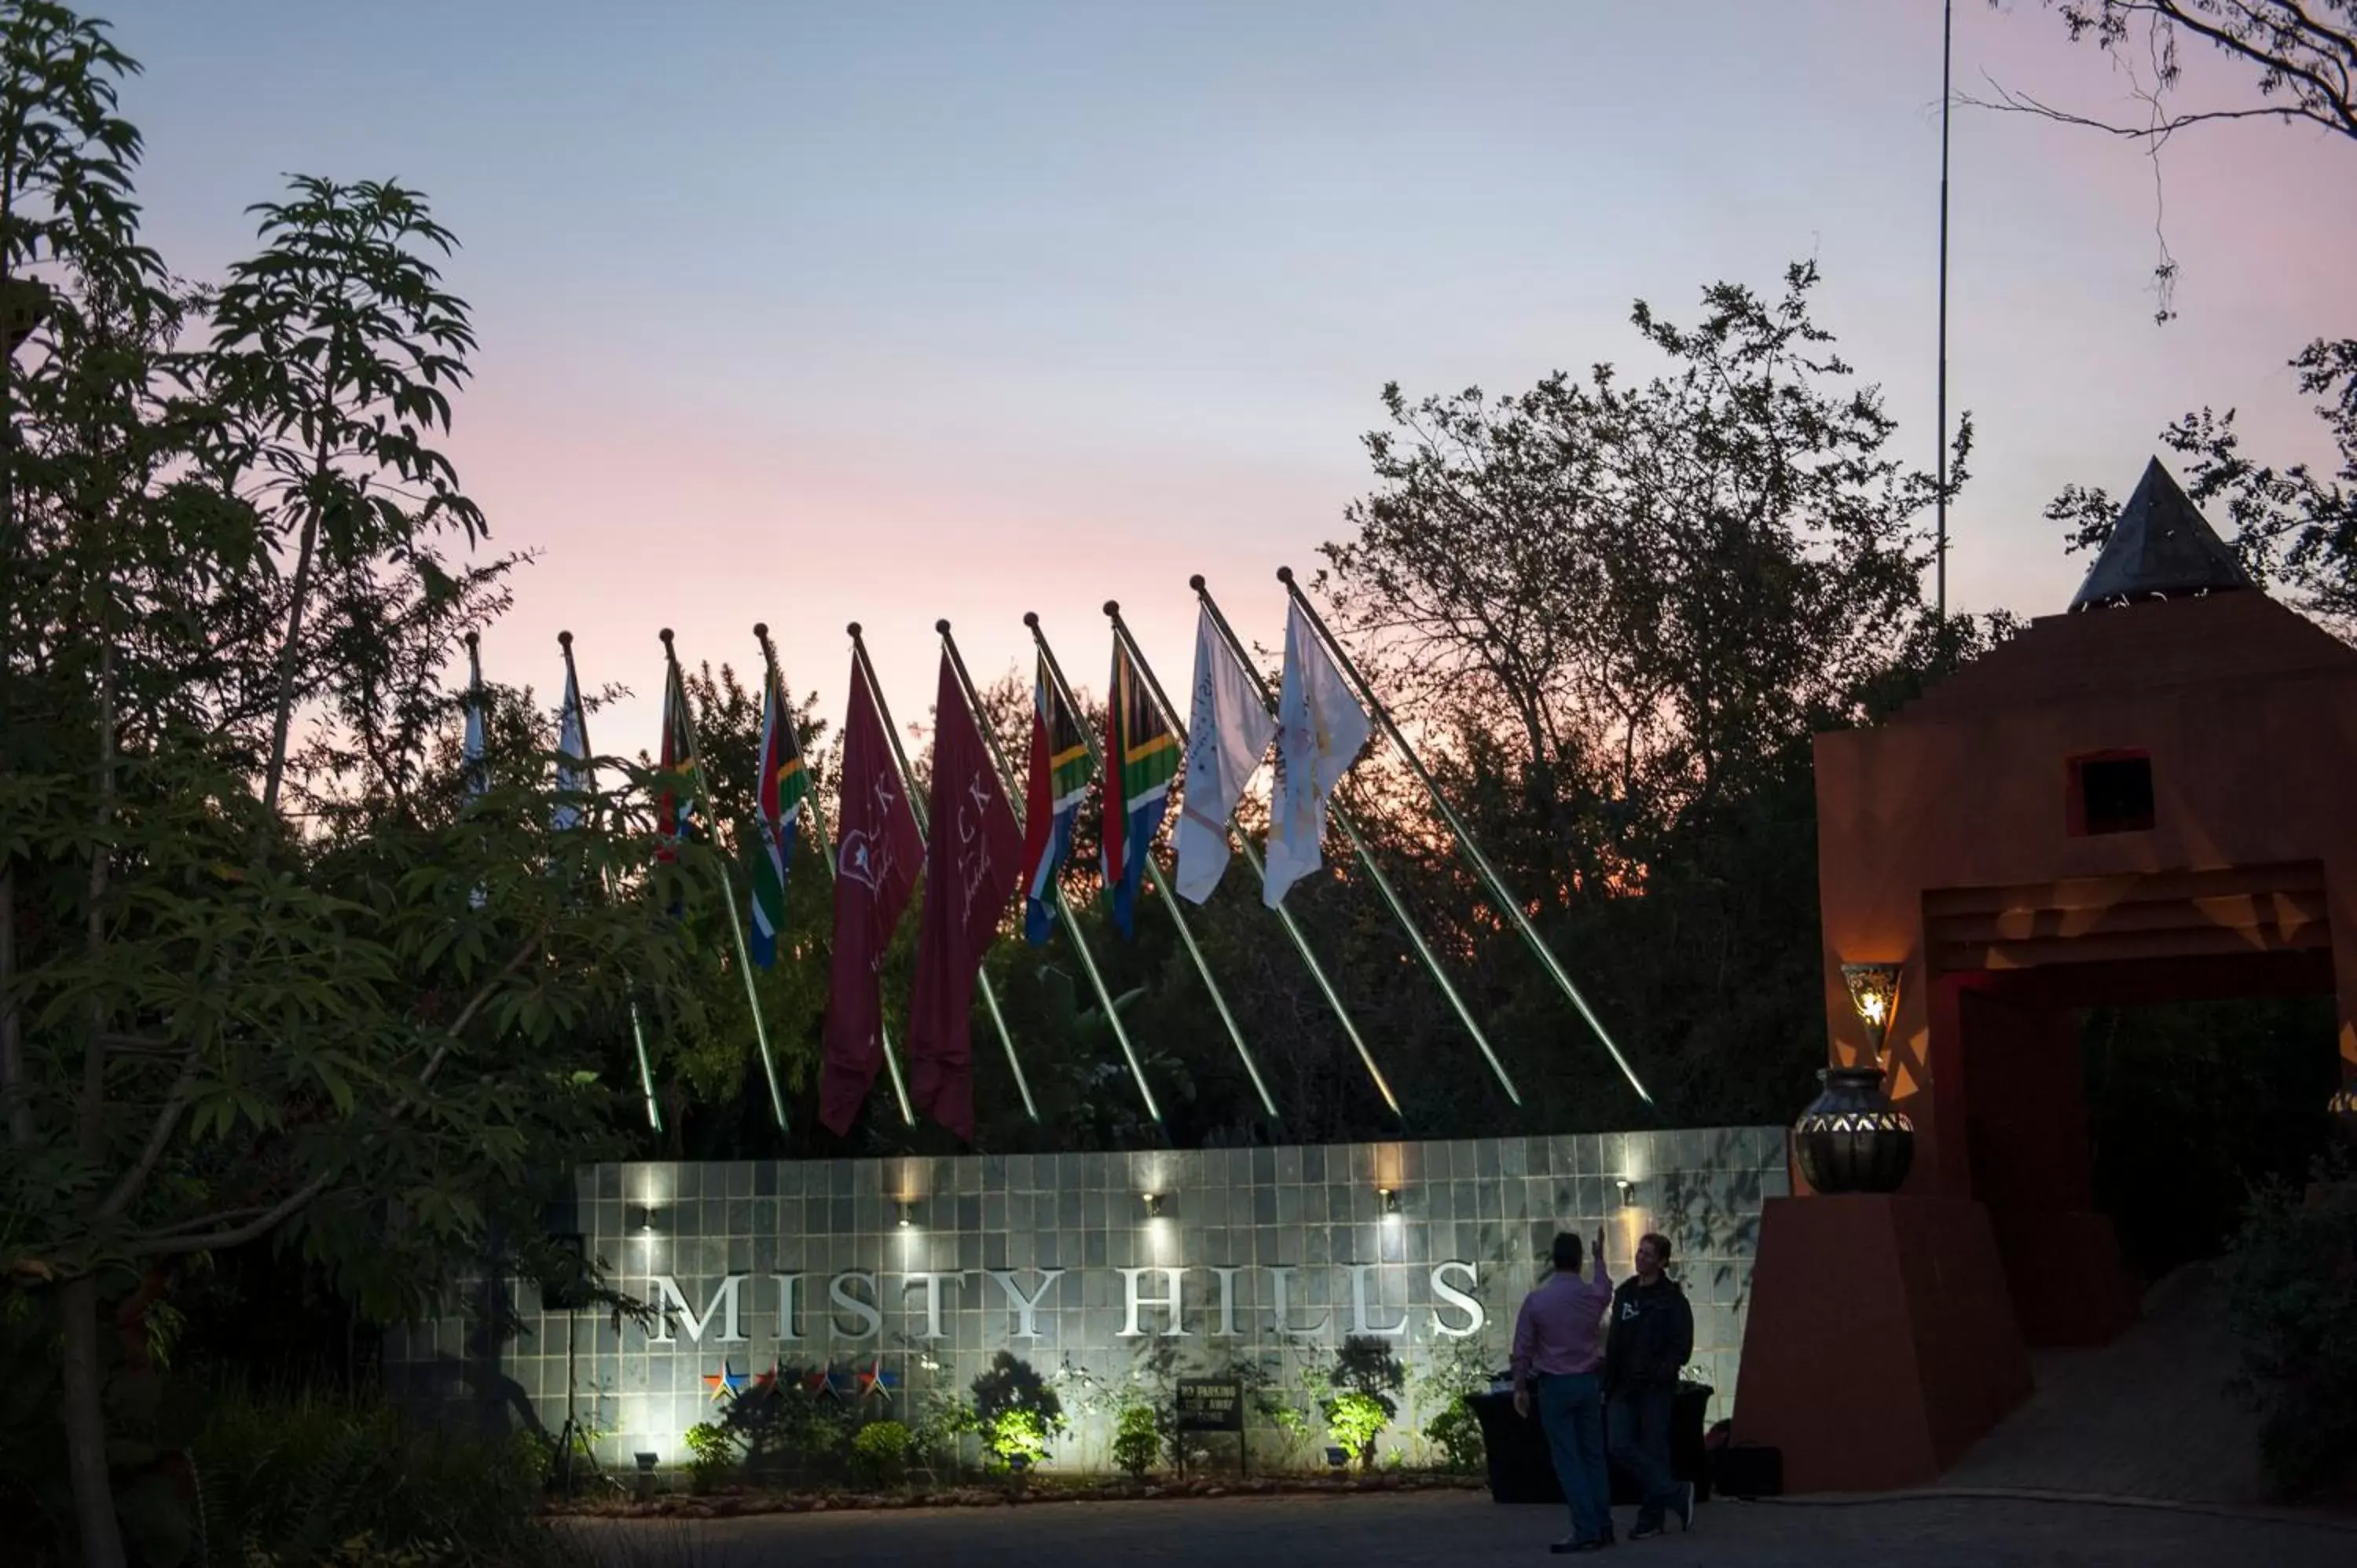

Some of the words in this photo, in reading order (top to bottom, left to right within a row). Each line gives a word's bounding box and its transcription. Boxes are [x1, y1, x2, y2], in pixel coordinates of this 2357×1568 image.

[648, 1268, 1066, 1343] MISTY
[1114, 1258, 1486, 1338] HILLS
[1197, 1385, 1237, 1398] PARKING
